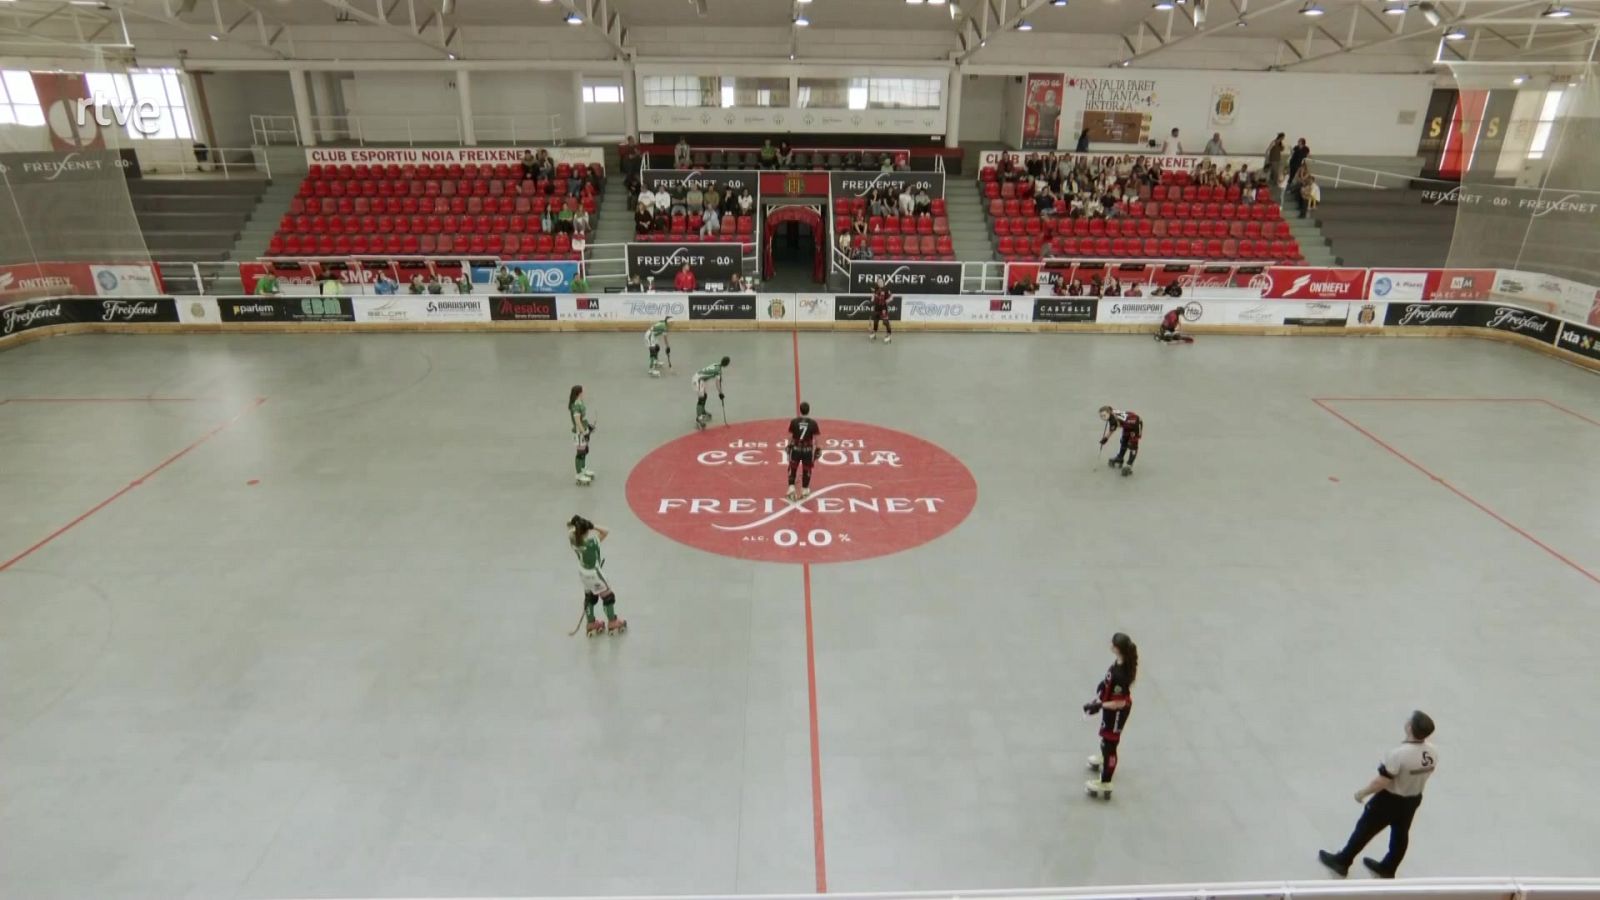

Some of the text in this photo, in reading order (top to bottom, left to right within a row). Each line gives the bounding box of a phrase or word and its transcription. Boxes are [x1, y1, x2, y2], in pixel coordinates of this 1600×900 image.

[312, 150, 523, 162] CLUB ESPORTIU NOIA FREIXENE
[1519, 194, 1598, 217] FREIXENET
[102, 301, 158, 321] Freixenet
[623, 301, 684, 315] Reno
[904, 301, 964, 317] Reno
[1399, 304, 1458, 325] Freixenet
[3, 304, 61, 333] Freixenet
[1486, 307, 1548, 332] Freixenet
[799, 425, 808, 440] 7
[729, 439, 768, 448] des
[825, 439, 865, 448] 951
[697, 450, 769, 465] C.E.
[773, 529, 832, 546] 0.0
[838, 533, 851, 543] %
